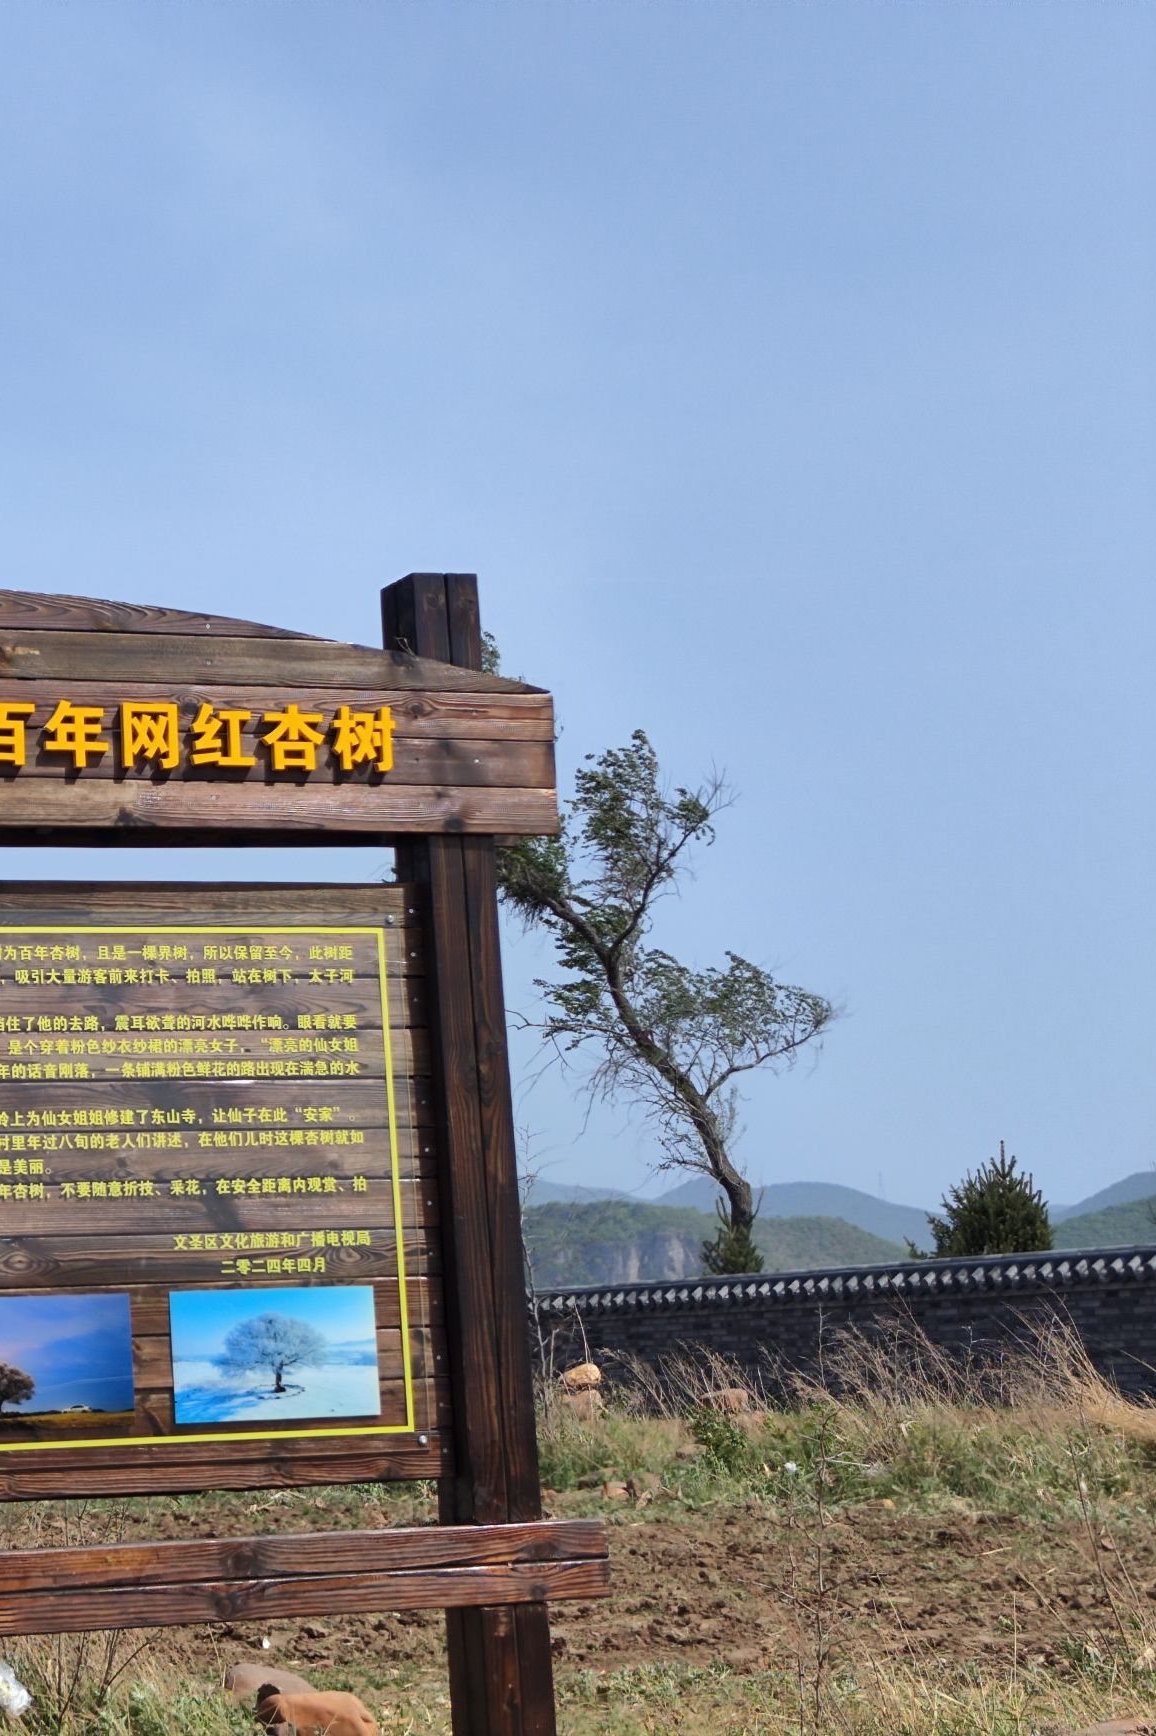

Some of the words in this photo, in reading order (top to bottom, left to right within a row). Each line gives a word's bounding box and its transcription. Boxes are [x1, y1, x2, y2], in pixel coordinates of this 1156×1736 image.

[172, 1230, 372, 1251] 文圣区文化旅游和广播电视局
[220, 1257, 327, 1275] 二零二四年四月
